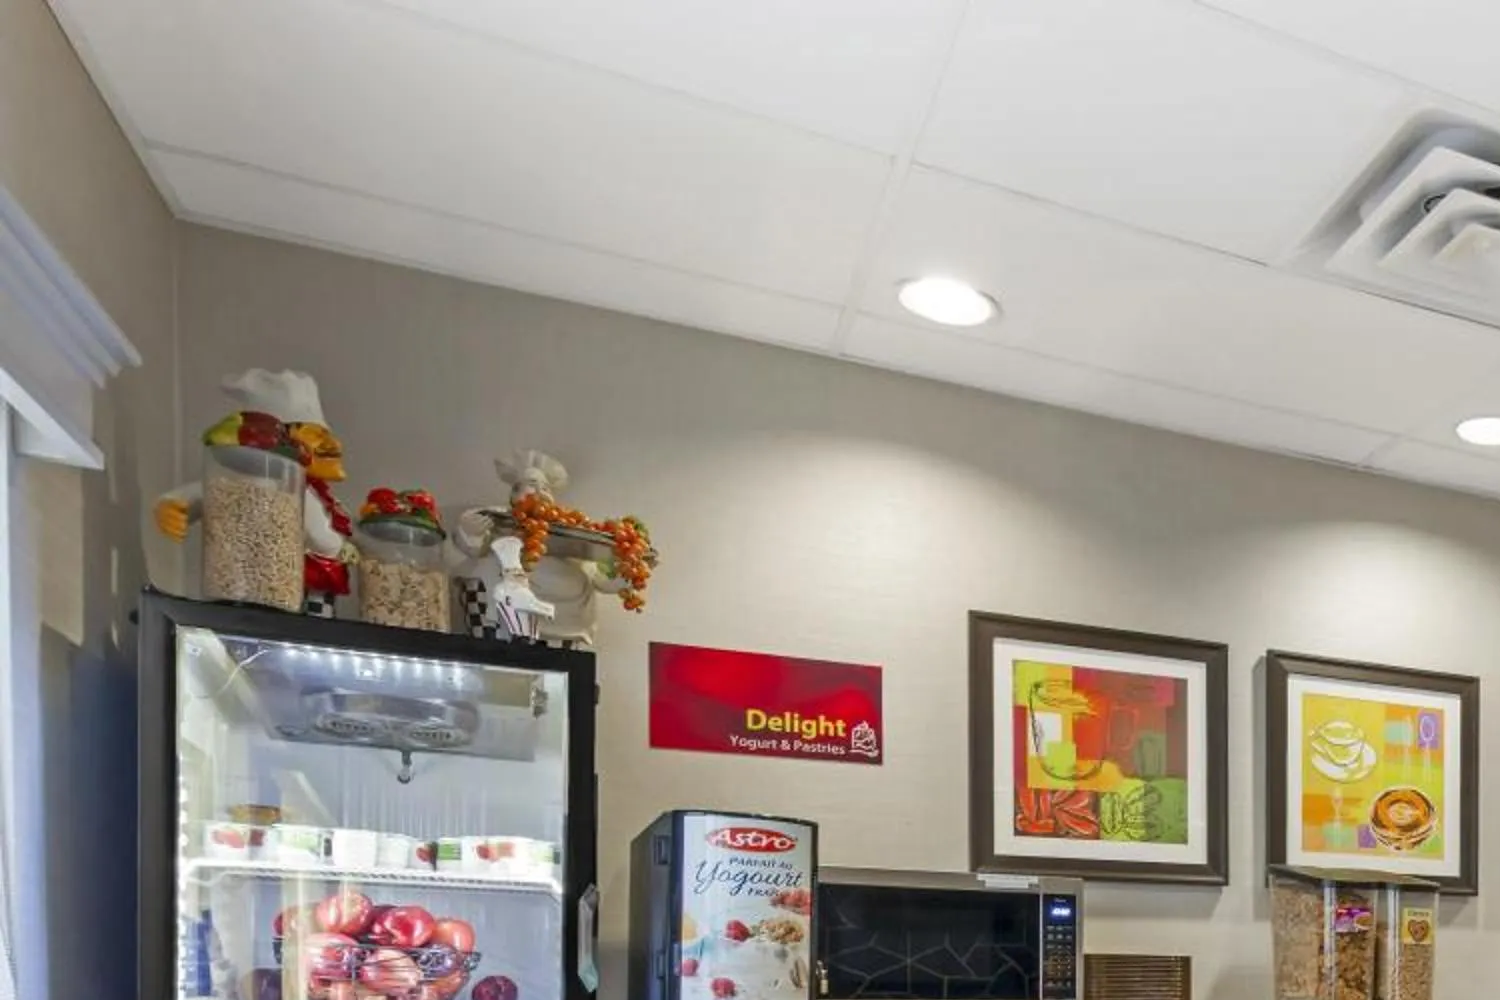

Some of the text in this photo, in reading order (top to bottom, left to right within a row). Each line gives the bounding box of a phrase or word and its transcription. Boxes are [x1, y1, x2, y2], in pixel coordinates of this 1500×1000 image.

[745, 708, 846, 740] Delight
[730, 735, 846, 755] Yogurt & Pastries
[706, 828, 794, 849] Astro
[693, 859, 803, 897] Yogourt
